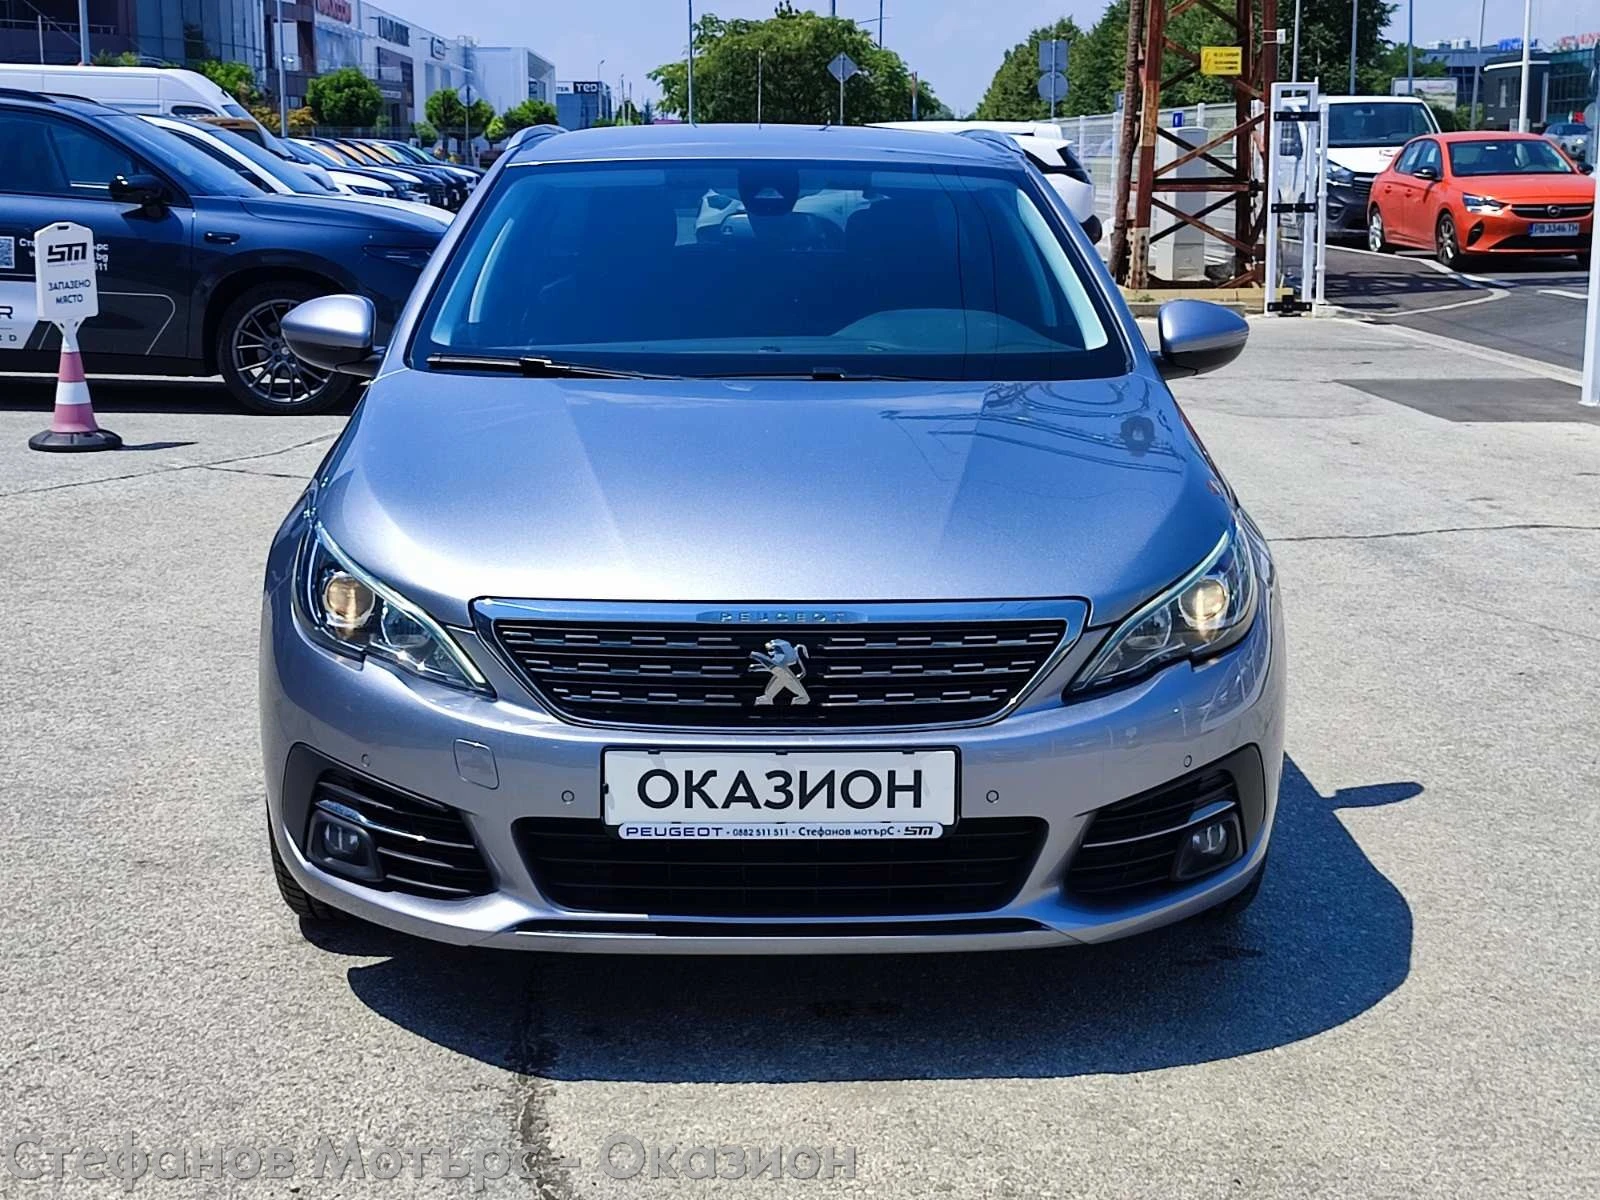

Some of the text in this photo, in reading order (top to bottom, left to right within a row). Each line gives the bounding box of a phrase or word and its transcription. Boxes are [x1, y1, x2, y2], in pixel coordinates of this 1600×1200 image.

[48, 279, 91, 291] ЗАПАЗЕНО
[56, 294, 83, 305] МЯСТО
[719, 610, 846, 623] PEUGEOT
[637, 768, 922, 810] ОКАЗИОН
[626, 826, 723, 837] PEUGEOT
[798, 826, 851, 838] Стефанов
